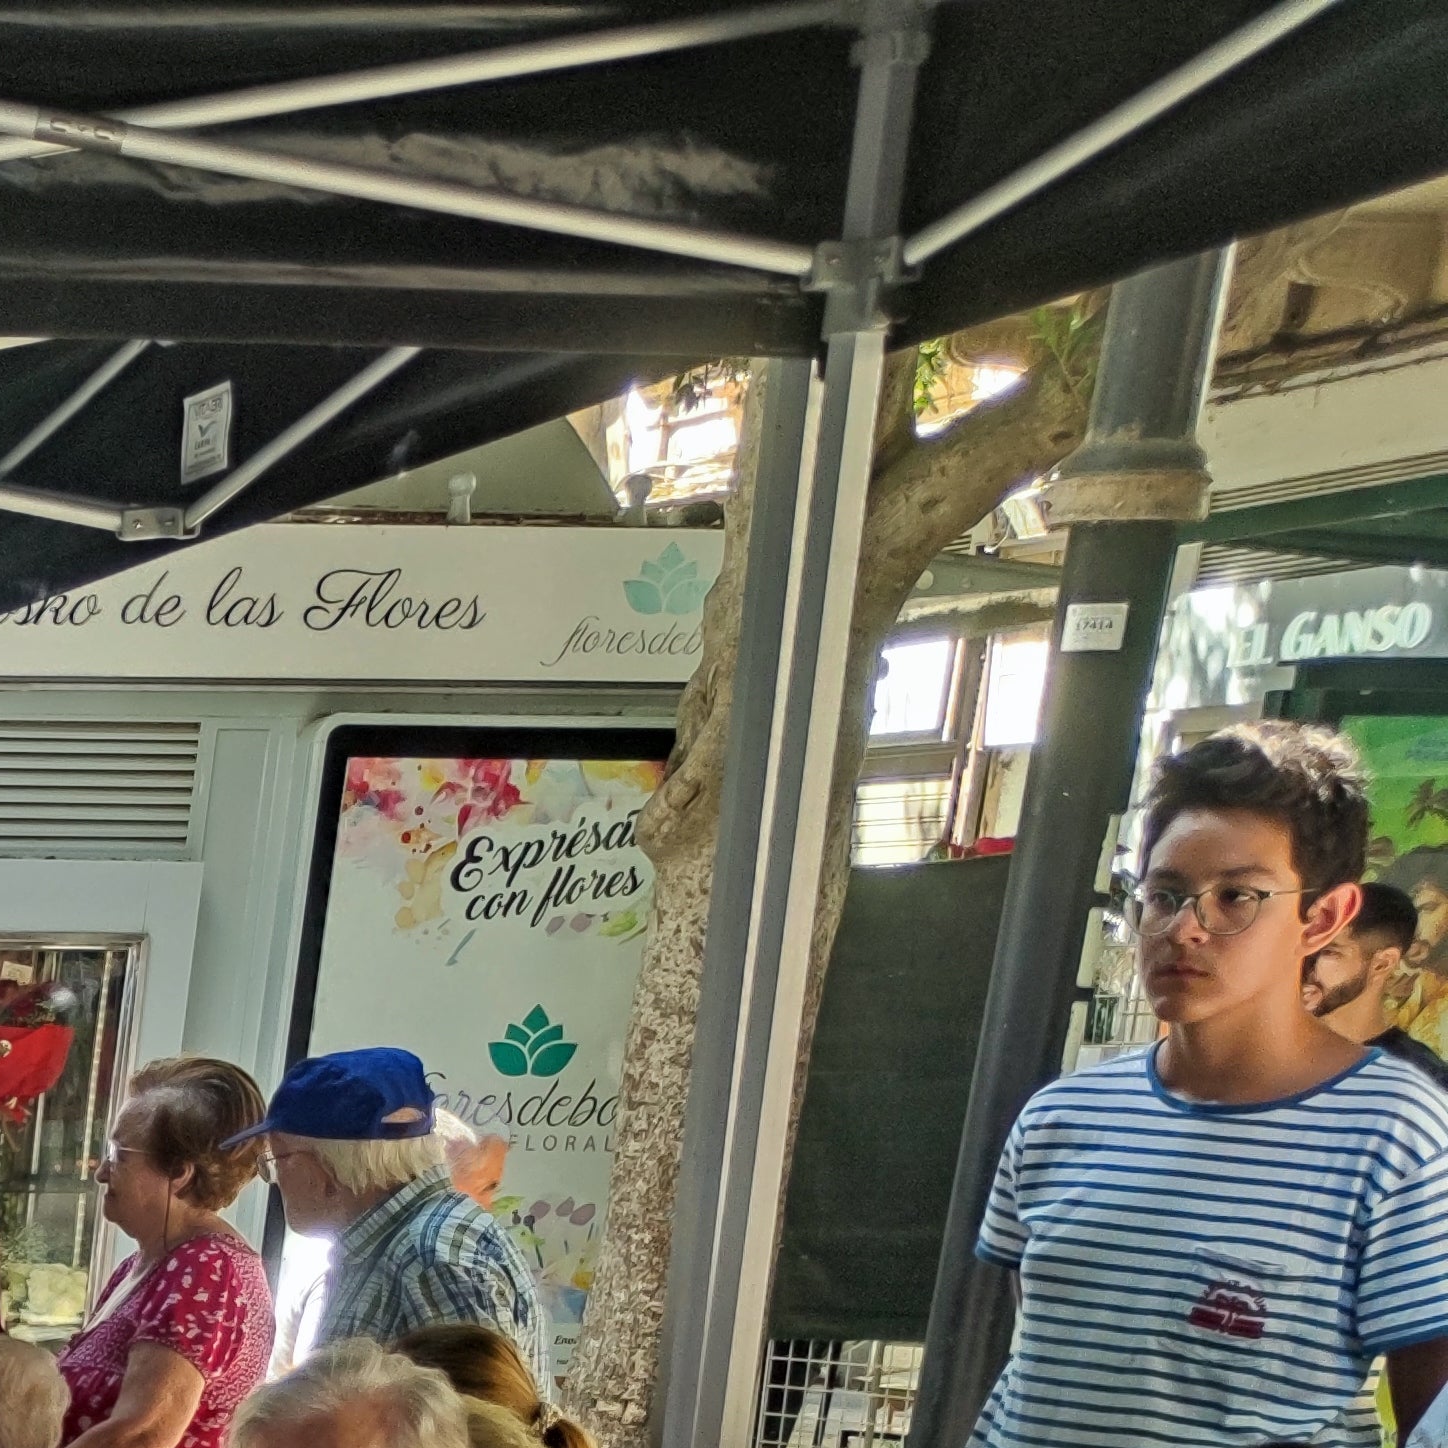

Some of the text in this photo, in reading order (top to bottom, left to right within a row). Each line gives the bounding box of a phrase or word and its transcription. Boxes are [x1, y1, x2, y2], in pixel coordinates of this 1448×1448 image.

[121, 570, 187, 626] de
[206, 566, 284, 628] las
[303, 568, 487, 631] Flores
[540, 615, 704, 667] floresdeb
[1227, 602, 1432, 667] EL GANSO
[466, 864, 645, 928] con flores
[508, 1134, 617, 1152] FLORAL
